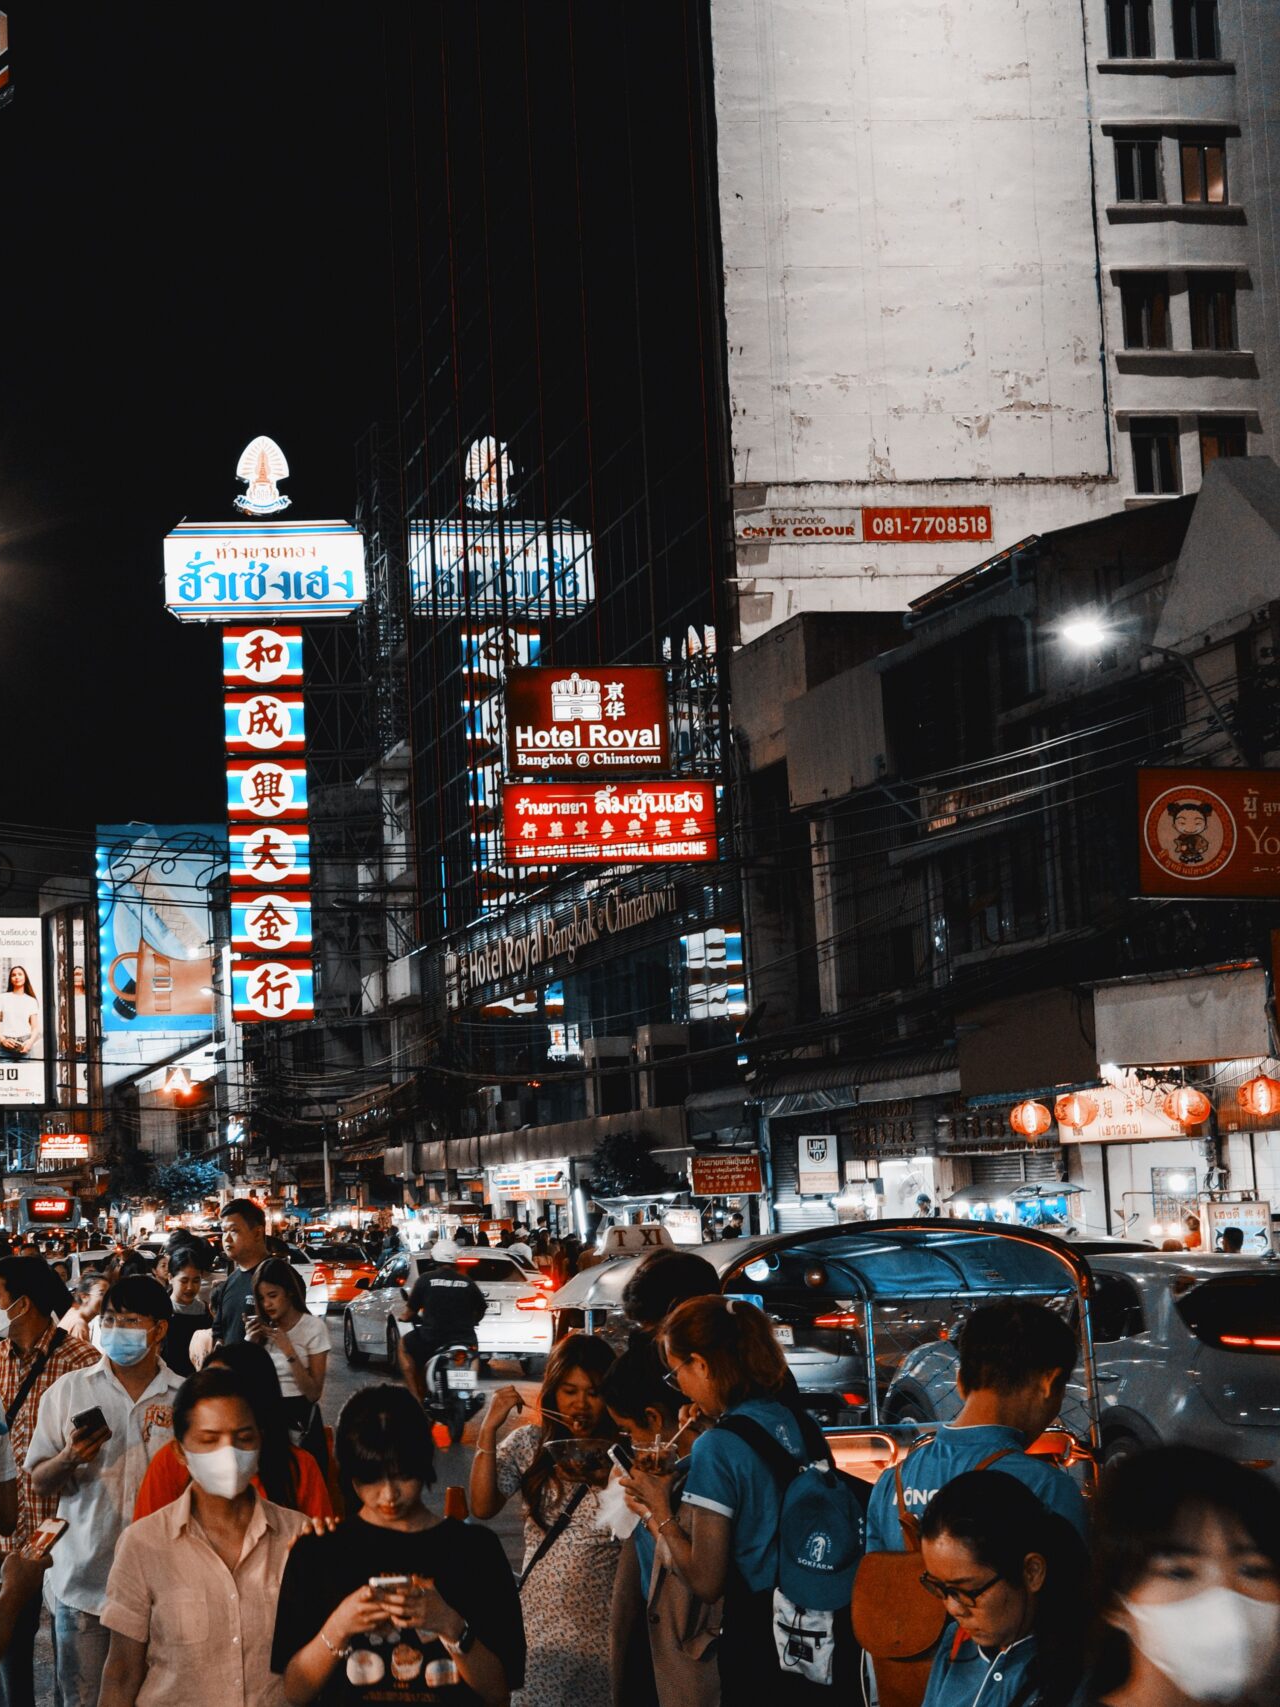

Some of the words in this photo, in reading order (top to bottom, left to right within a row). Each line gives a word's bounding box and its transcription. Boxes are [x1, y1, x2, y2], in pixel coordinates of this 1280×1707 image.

[742, 526, 786, 538] CMYK
[793, 526, 855, 537] COLOUR
[872, 516, 988, 535] 081-7708518
[515, 725, 581, 748] Hotel
[589, 724, 661, 749] Royal
[517, 754, 573, 769] Bangkok
[576, 753, 590, 767] @
[593, 753, 661, 765] Chinatown
[515, 846, 535, 858] LIM
[602, 844, 652, 857] NATURAL
[653, 842, 708, 855] MEDICINE
[470, 939, 502, 989] Hotel
[504, 920, 544, 977] Royal
[547, 900, 599, 964] Bangkok
[605, 882, 678, 935] Chinatown
[613, 1228, 664, 1247] TXI
